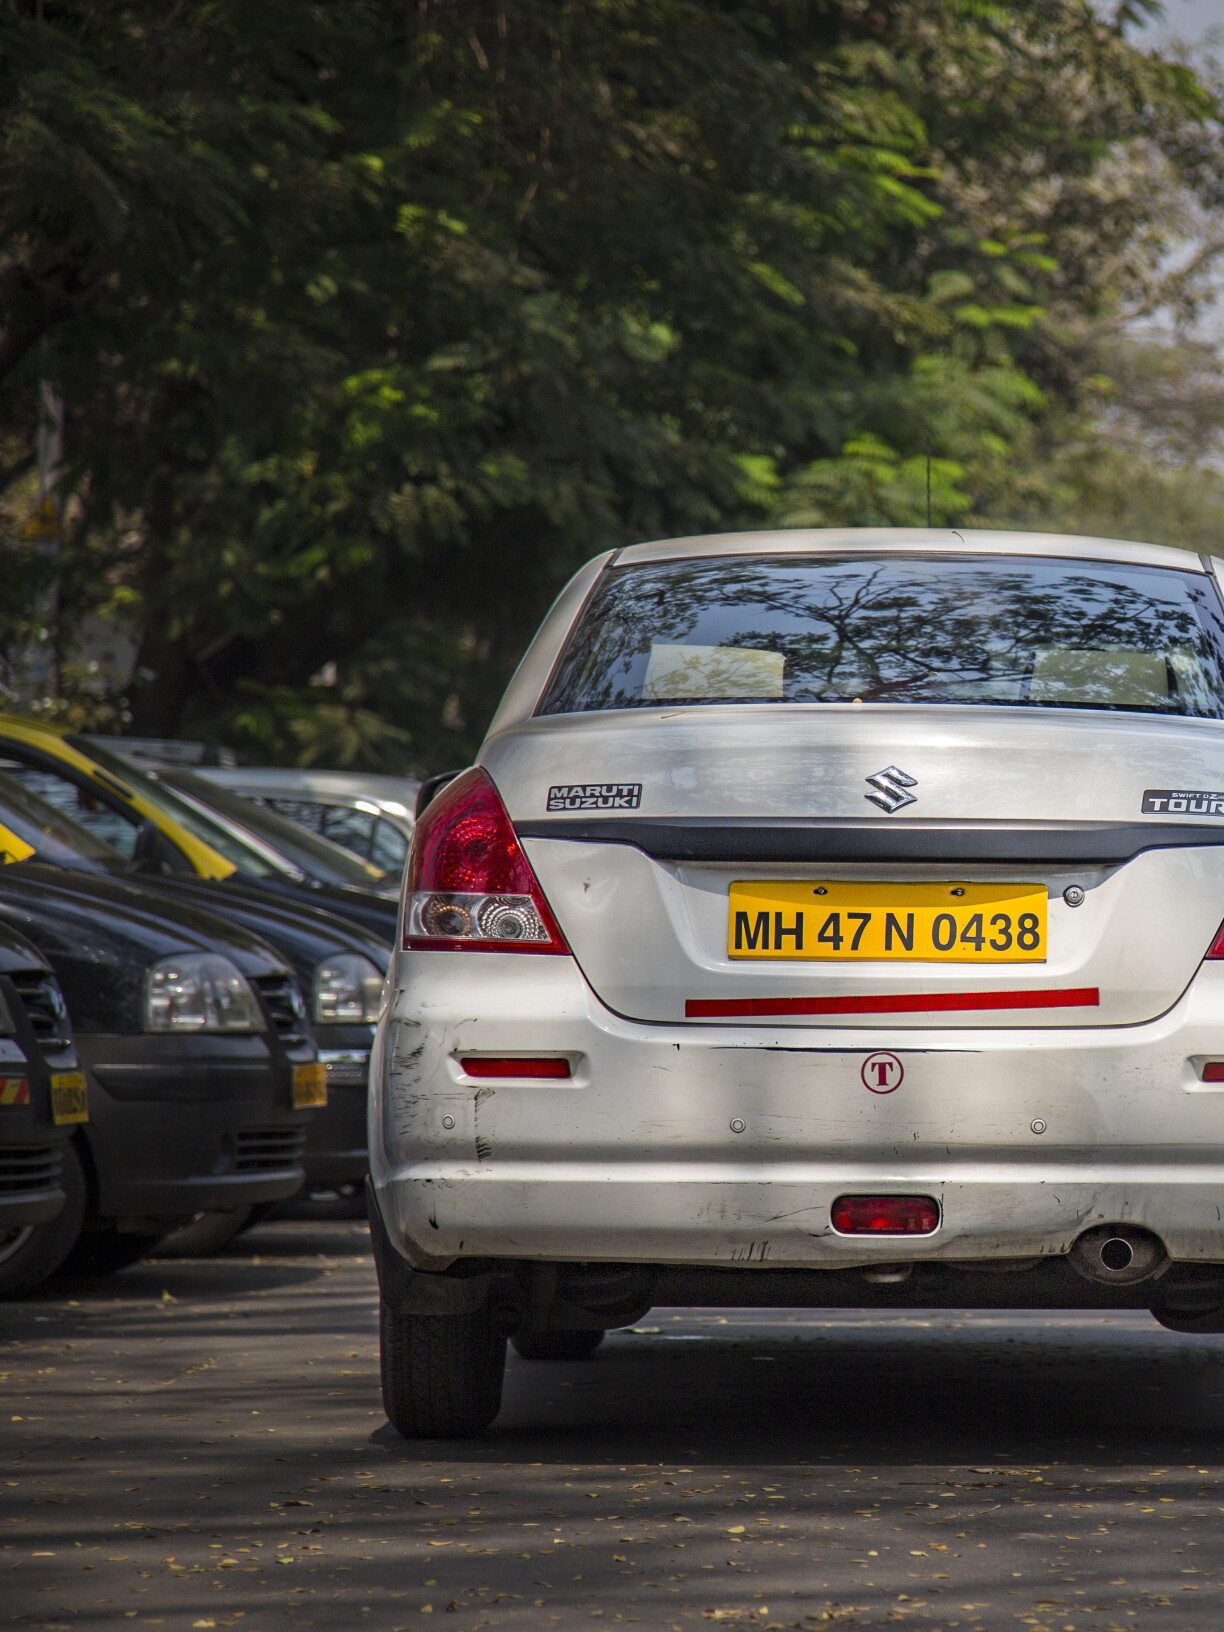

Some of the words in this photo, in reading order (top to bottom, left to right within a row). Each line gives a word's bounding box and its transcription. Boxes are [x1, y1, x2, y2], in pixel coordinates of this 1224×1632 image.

[550, 785, 639, 798] MARUTI
[549, 797, 637, 809] SUZUKI
[734, 911, 804, 951] MH
[817, 912, 872, 951] 47
[884, 912, 915, 951] N
[931, 912, 1040, 952] 0438
[870, 1061, 893, 1087] T
